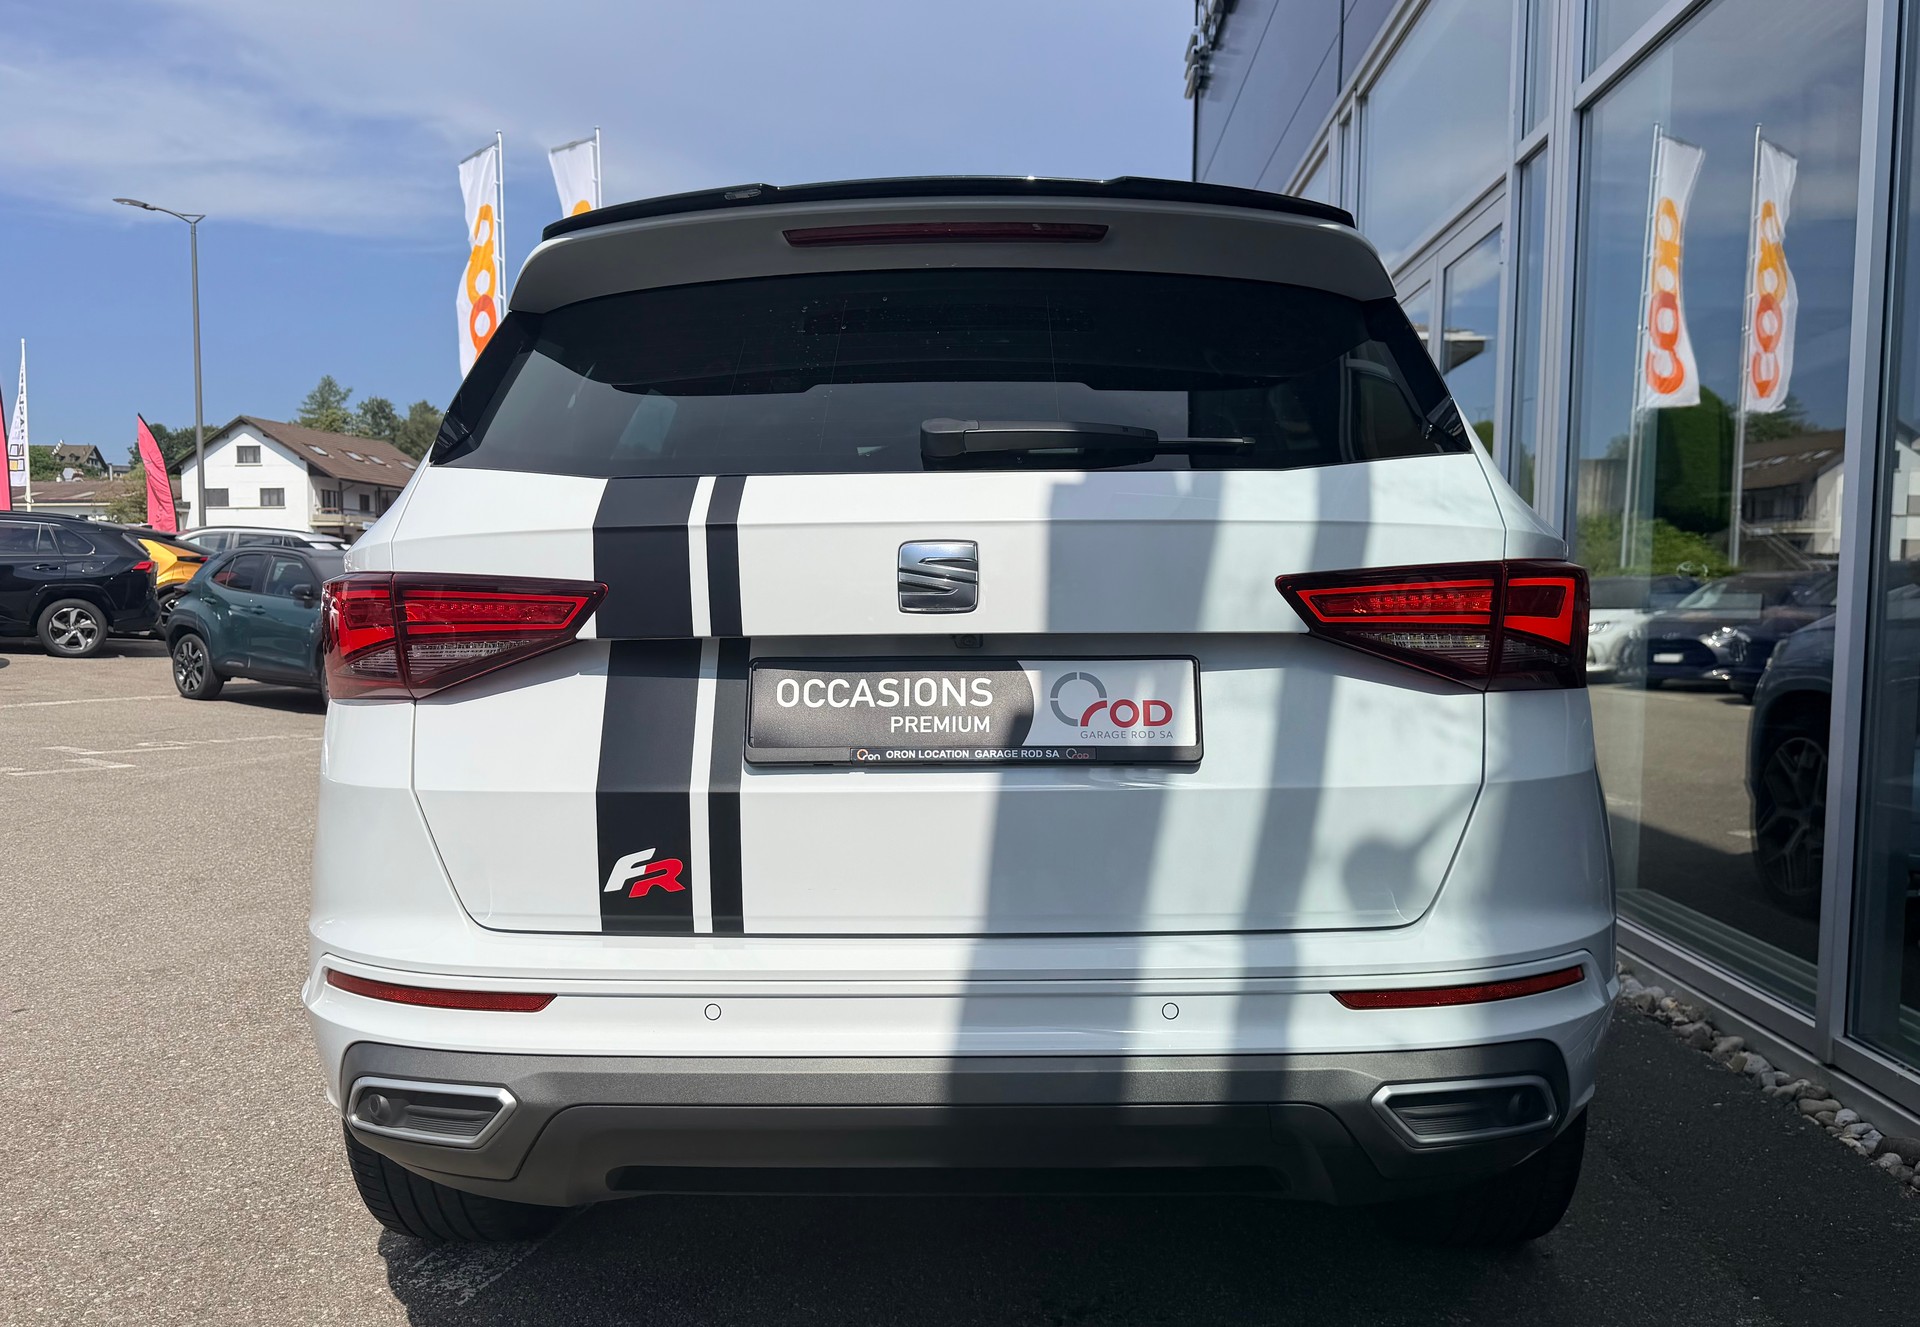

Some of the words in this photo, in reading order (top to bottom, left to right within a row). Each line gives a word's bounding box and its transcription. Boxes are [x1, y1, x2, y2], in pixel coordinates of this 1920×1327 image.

[776, 677, 994, 708] OCCASIONS
[890, 715, 990, 733] PREMIUM
[1080, 730, 1126, 739] GARAGE
[1131, 730, 1156, 739] ROD
[1159, 730, 1174, 739] SA
[885, 749, 916, 759] ORON
[918, 749, 970, 759] LOCATION
[974, 749, 1018, 758] GARAGE
[1021, 749, 1043, 758] ROD
[1045, 749, 1060, 758] SA
[603, 847, 686, 898] FR
